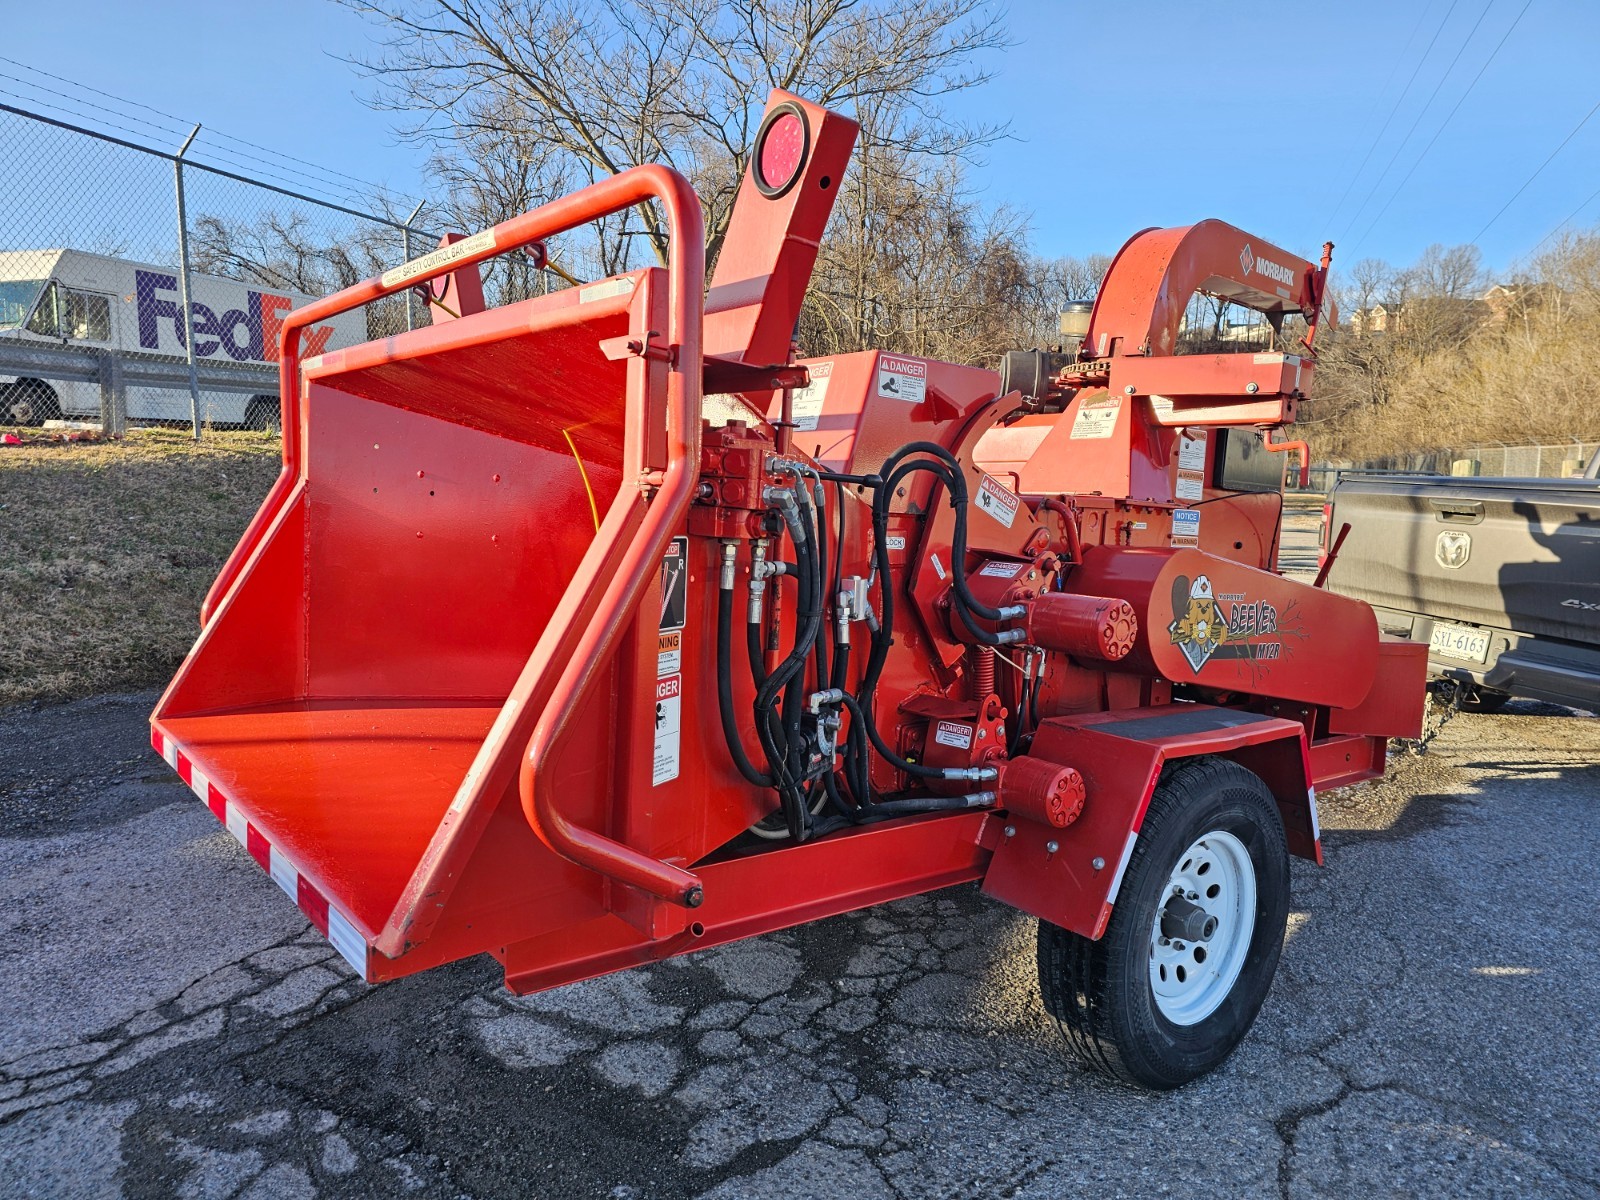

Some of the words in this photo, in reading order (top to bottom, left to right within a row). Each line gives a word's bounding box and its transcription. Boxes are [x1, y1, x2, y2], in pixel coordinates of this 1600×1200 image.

[403, 263, 422, 276] SAFETY
[423, 250, 452, 269] CONTROL
[451, 244, 465, 258] BAR
[1256, 257, 1294, 286] MORBARK
[135, 269, 335, 363] FedEx
[890, 361, 924, 376] DANGER
[989, 484, 1017, 509] DANGER
[1176, 512, 1198, 521] NOTICE
[886, 538, 903, 547] LOCK
[1177, 538, 1198, 546] WARNING
[678, 558, 684, 570] R
[1229, 600, 1276, 636] BEEVER
[658, 635, 679, 650] NING
[1257, 642, 1280, 659] M12R
[1432, 630, 1485, 654] SXL-6163
